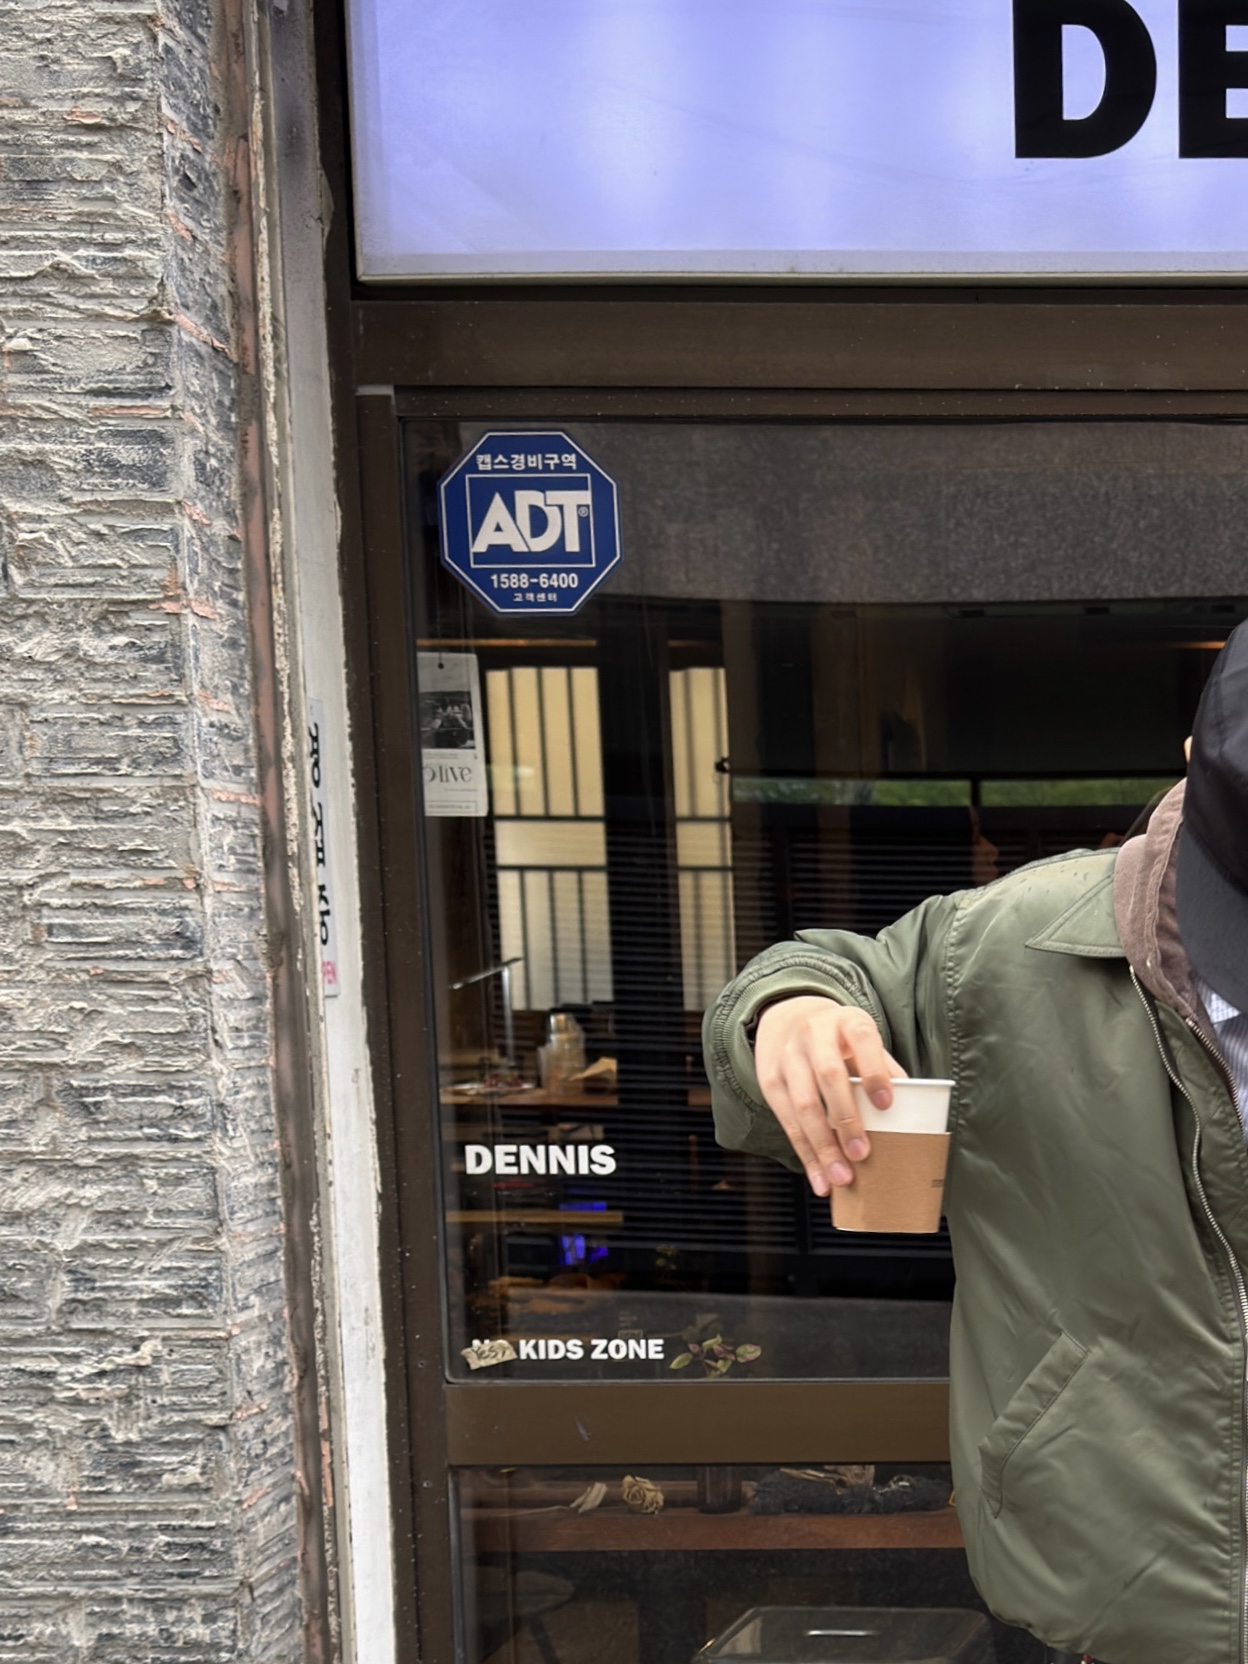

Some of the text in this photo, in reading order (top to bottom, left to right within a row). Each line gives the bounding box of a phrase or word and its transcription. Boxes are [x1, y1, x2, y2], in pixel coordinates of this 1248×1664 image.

[475, 453, 578, 471] 캡스경비구역
[490, 572, 579, 589] 1588-6400
[512, 592, 558, 603] 고객센터
[464, 1144, 617, 1175] DENNIS
[519, 1339, 584, 1360] KIDS
[590, 1339, 665, 1360] ZONE
